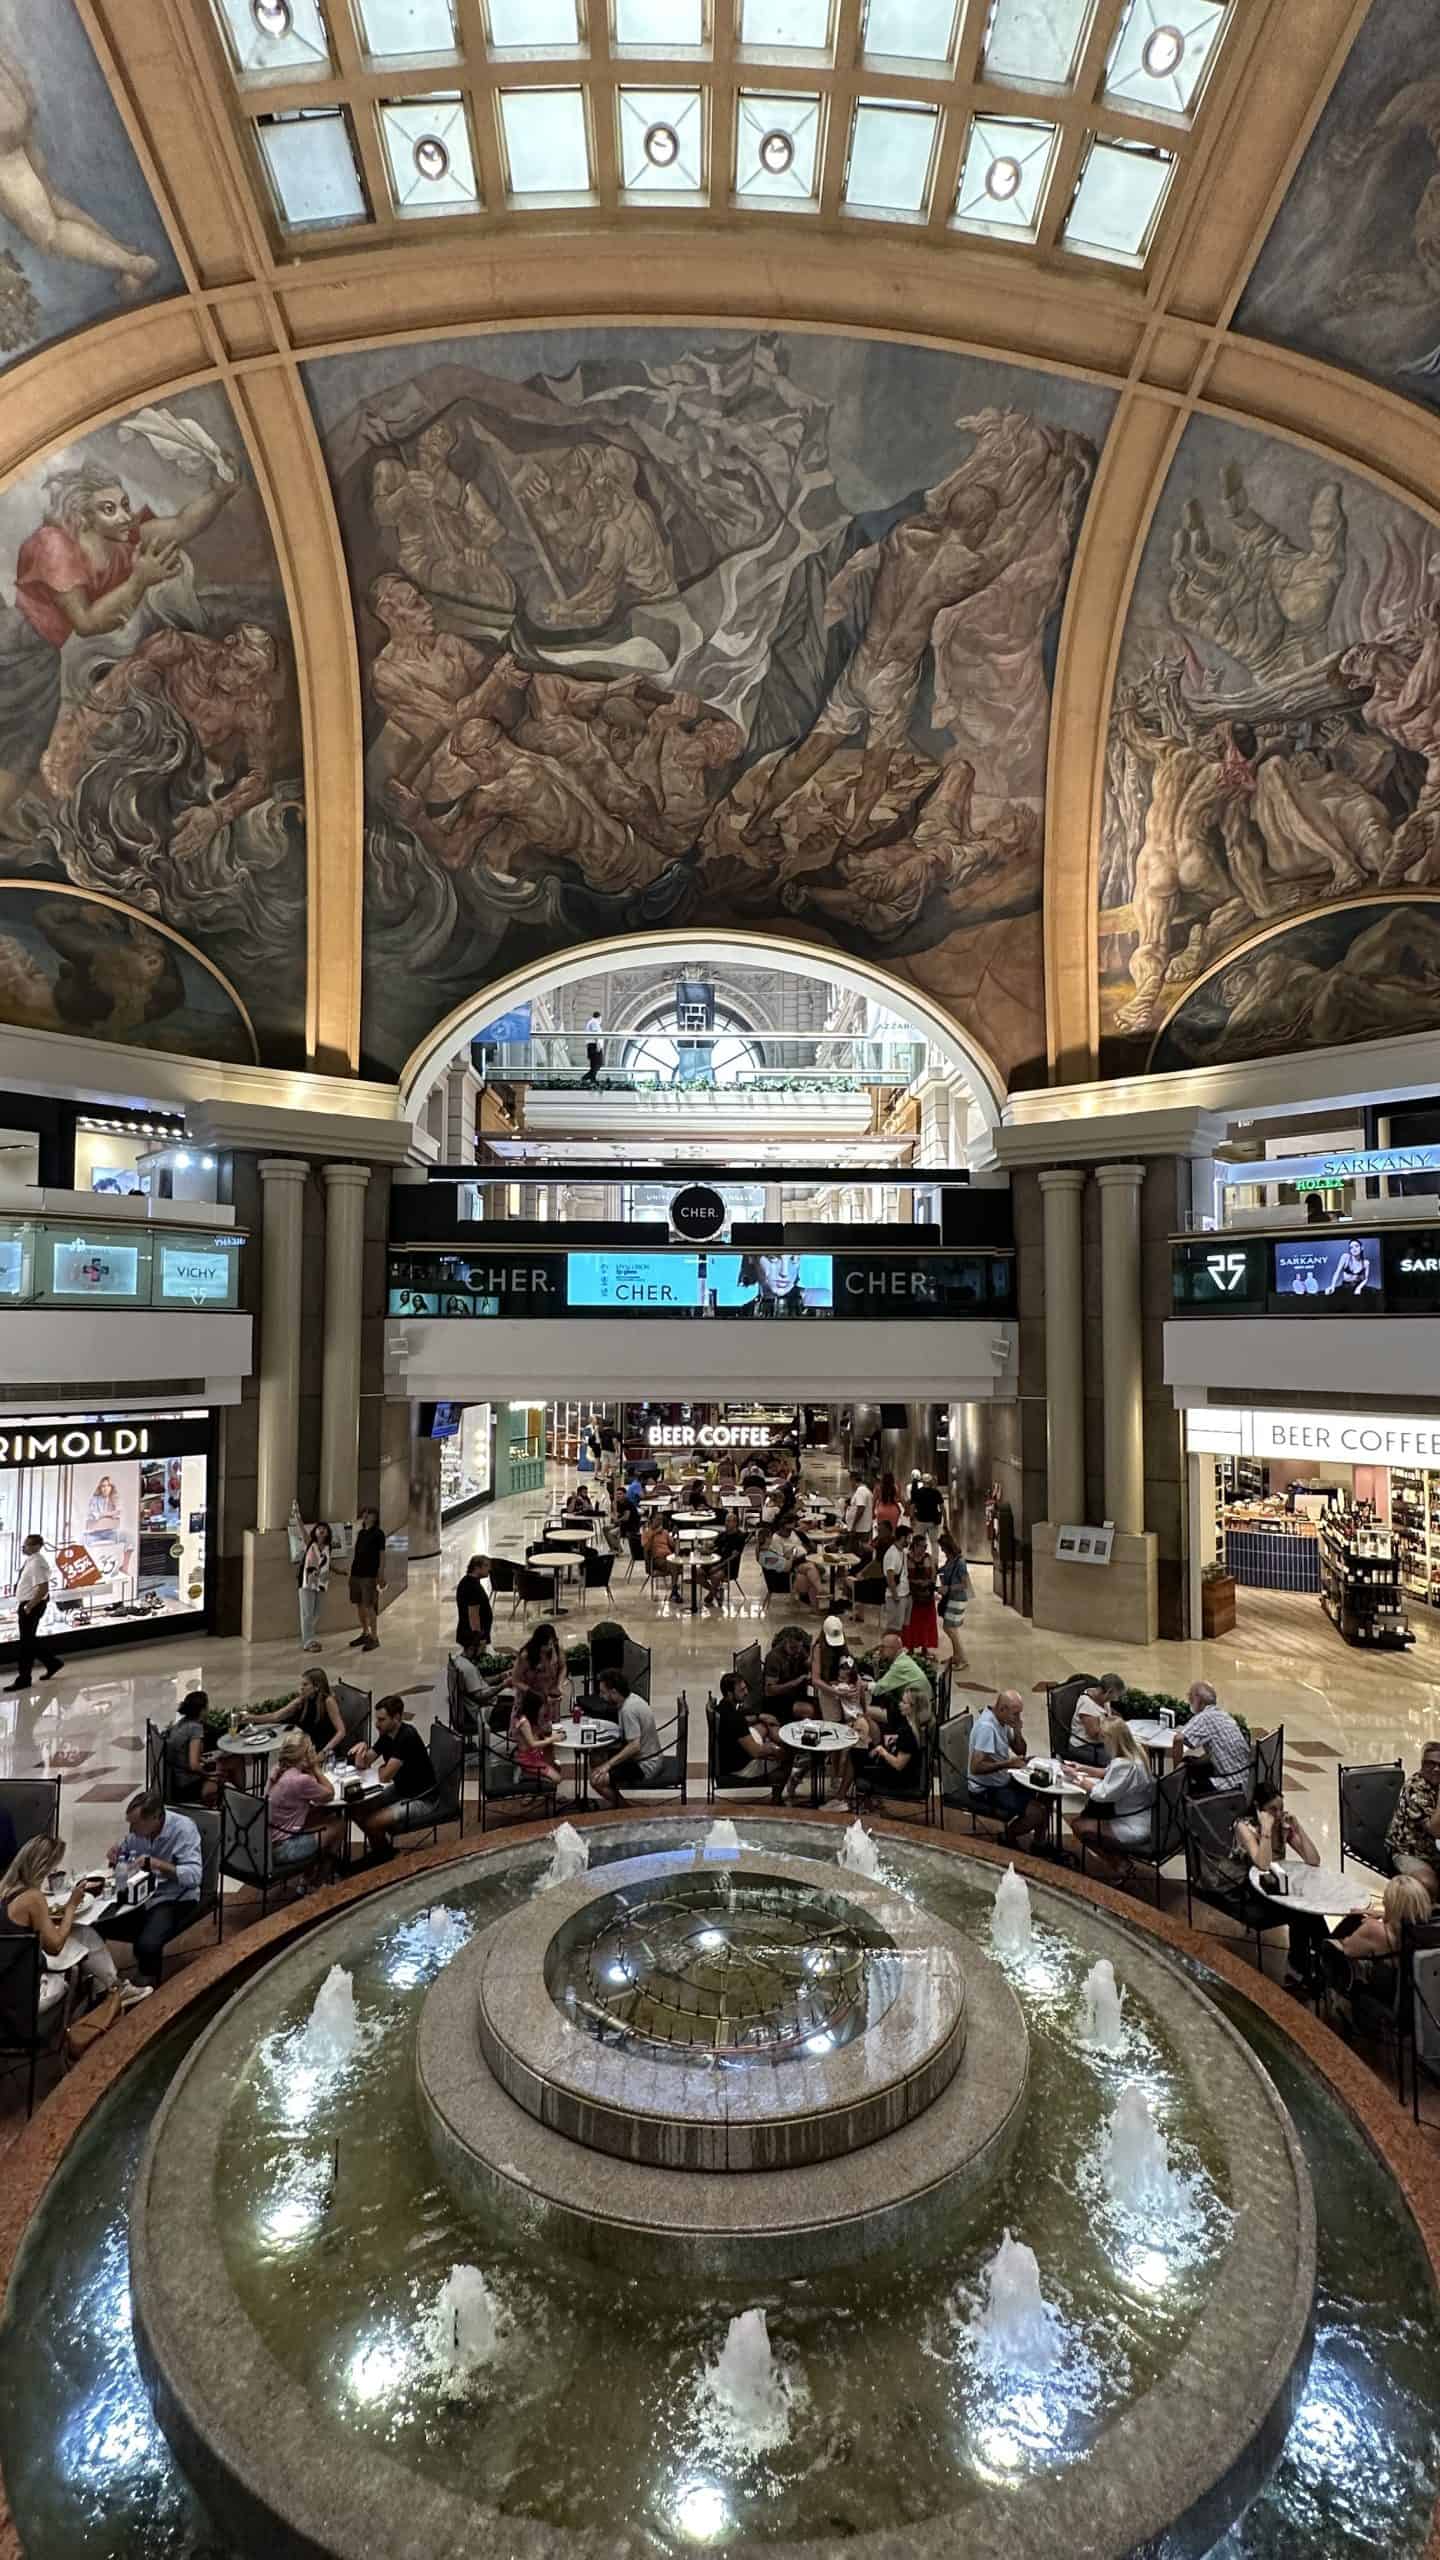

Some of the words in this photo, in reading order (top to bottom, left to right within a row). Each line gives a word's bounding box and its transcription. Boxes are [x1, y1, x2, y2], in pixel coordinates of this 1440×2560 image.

[1323, 1152, 1432, 1175] SARKANY
[680, 1207, 719, 1218] CHER.
[1279, 1255, 1328, 1267] SARKANY
[1401, 1258, 1440, 1272] SAR
[177, 1267, 217, 1279] VICHY
[465, 1268, 556, 1292] CHER.
[845, 1271, 935, 1295] CHER.
[615, 1284, 678, 1301] CHER.
[1272, 1425, 1330, 1448] BEER
[1341, 1429, 1440, 1455] COFFEE
